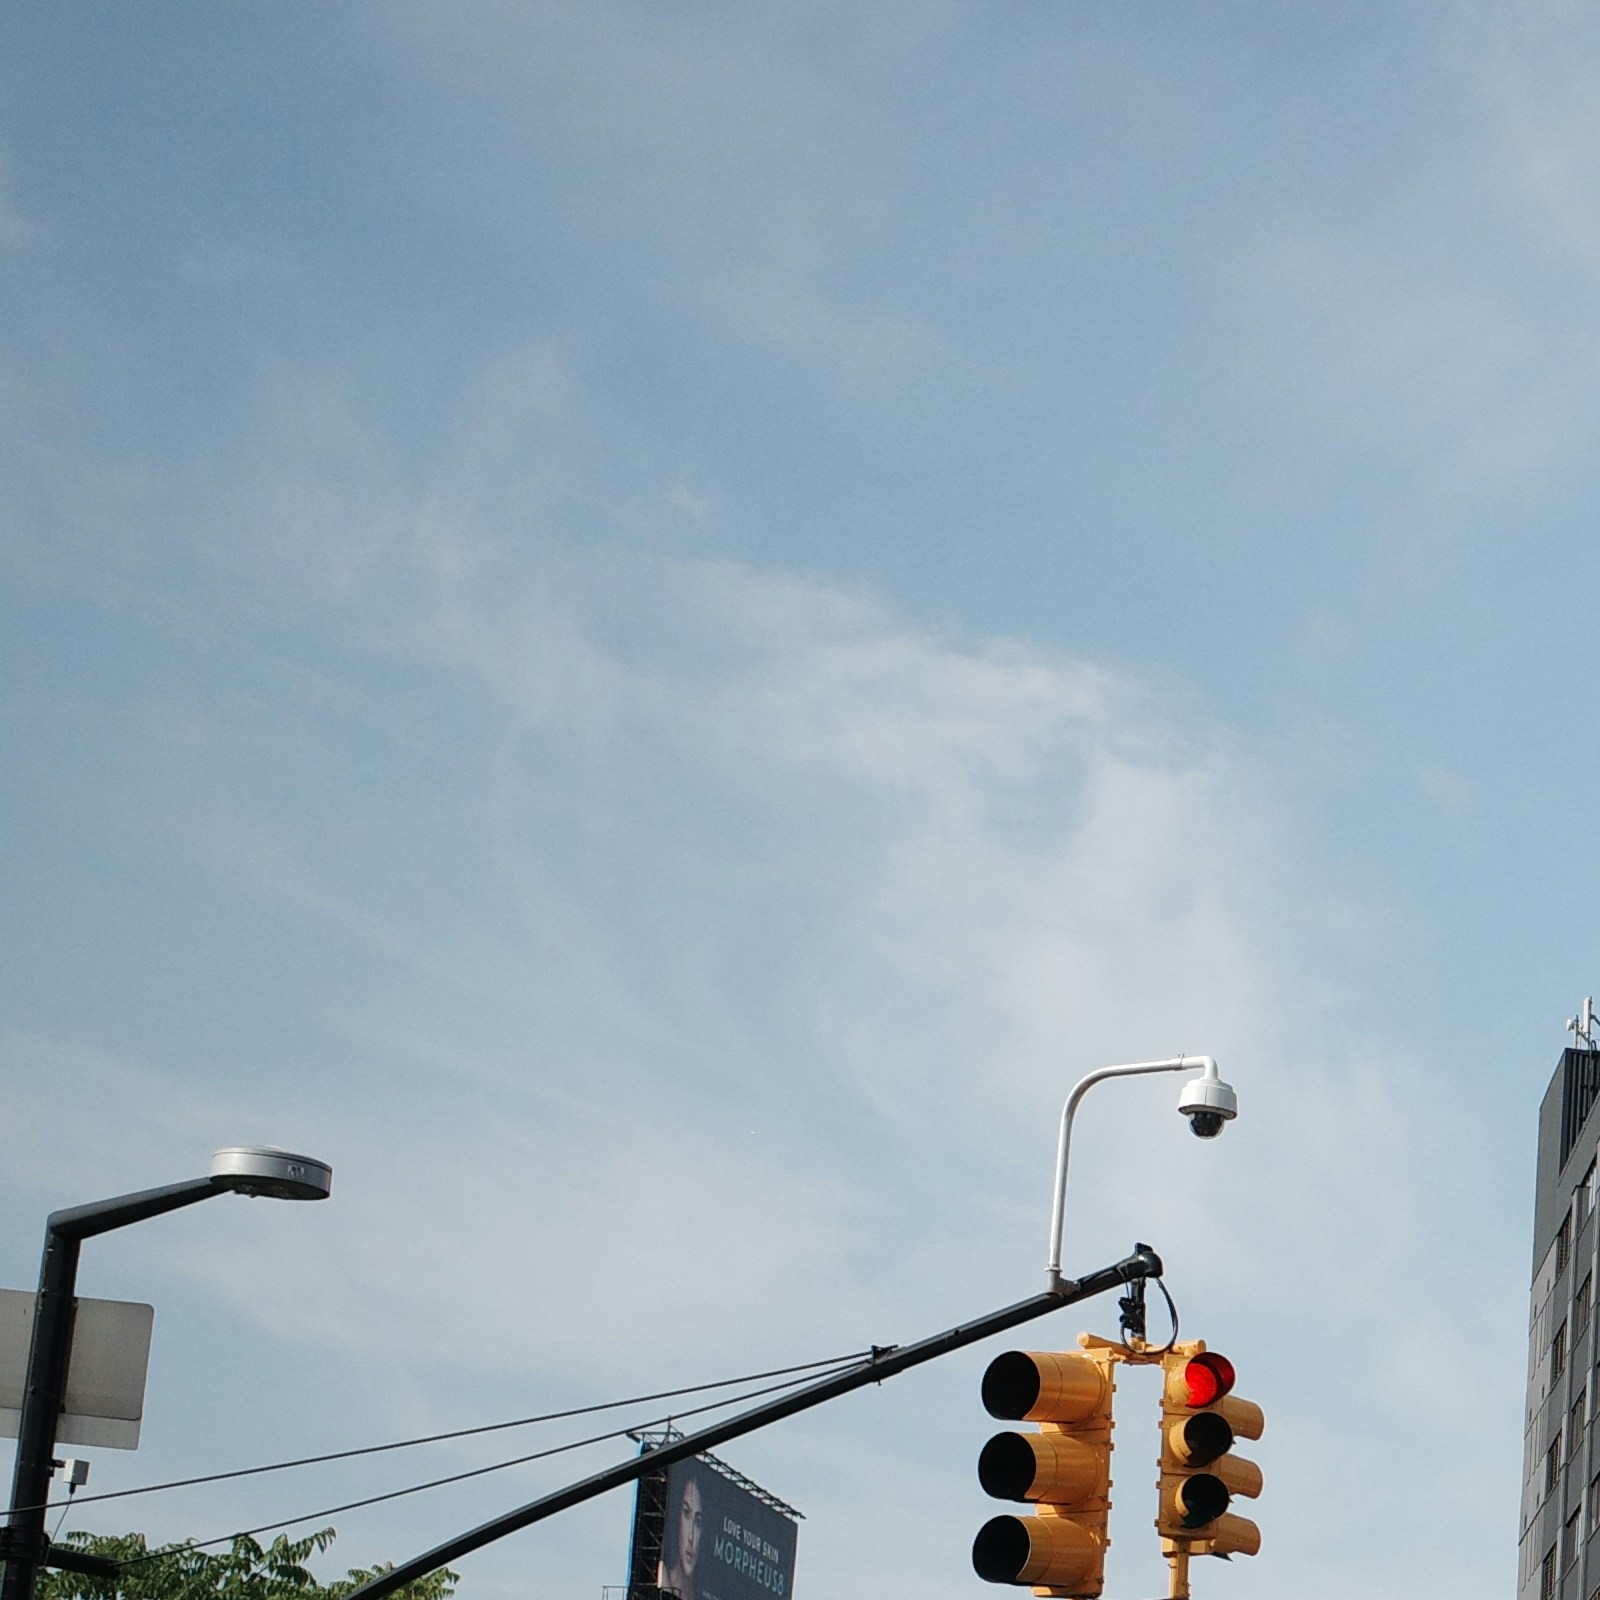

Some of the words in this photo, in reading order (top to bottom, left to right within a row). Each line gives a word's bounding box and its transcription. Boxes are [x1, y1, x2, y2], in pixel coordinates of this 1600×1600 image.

[713, 1534, 785, 1596] MORPHEUS8
[723, 1516, 742, 1540] LOVE
[743, 1528, 761, 1552] YOUR
[762, 1540, 779, 1564] SKIN
